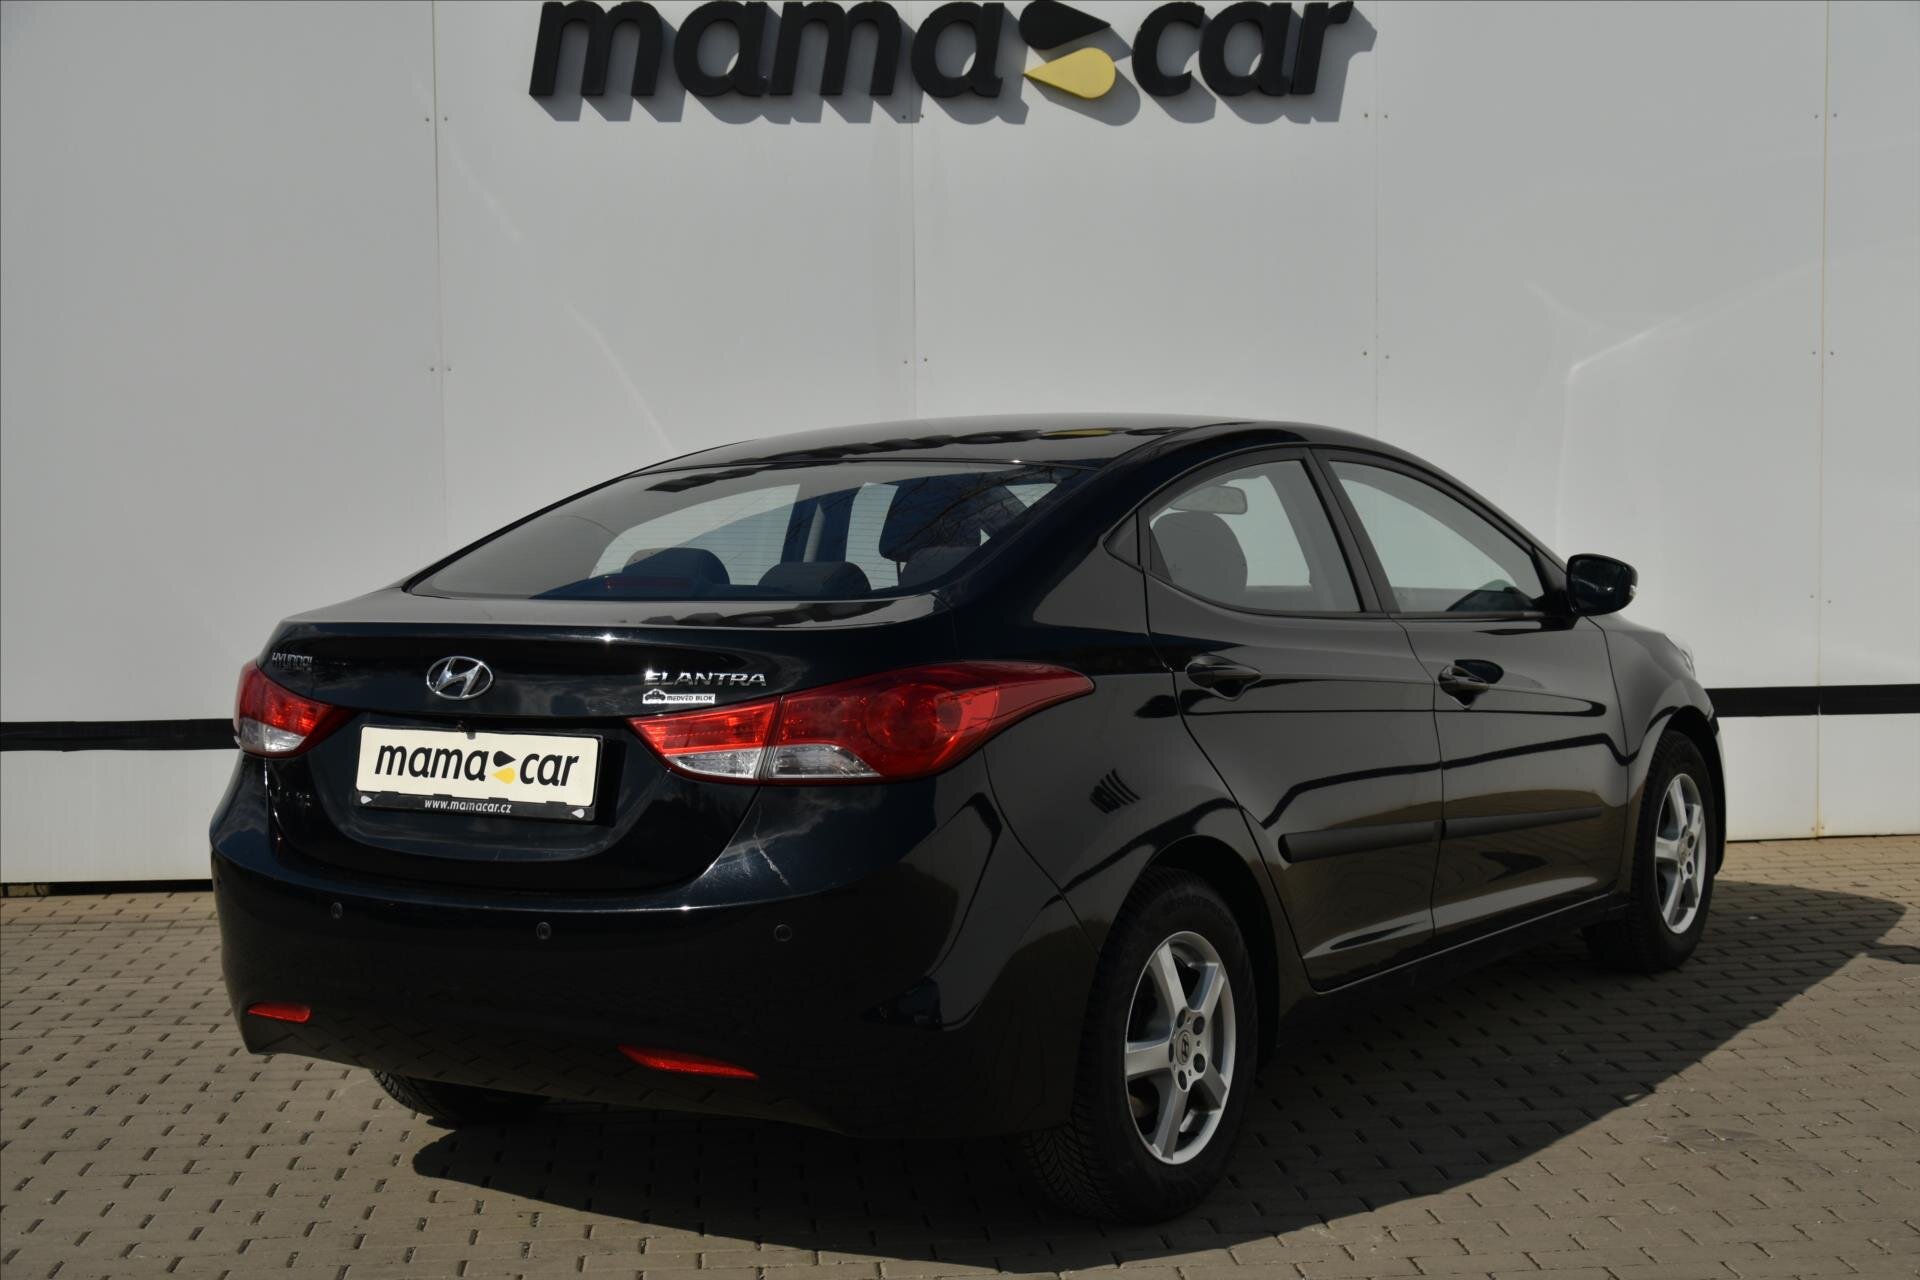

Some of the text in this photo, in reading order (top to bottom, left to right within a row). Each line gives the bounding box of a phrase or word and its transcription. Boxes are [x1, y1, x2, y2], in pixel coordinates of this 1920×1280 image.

[530, 1, 1354, 97] mama car
[644, 669, 767, 687] ELANTRA
[375, 744, 580, 787] mama car
[424, 799, 513, 814] www.mamacar.cz
